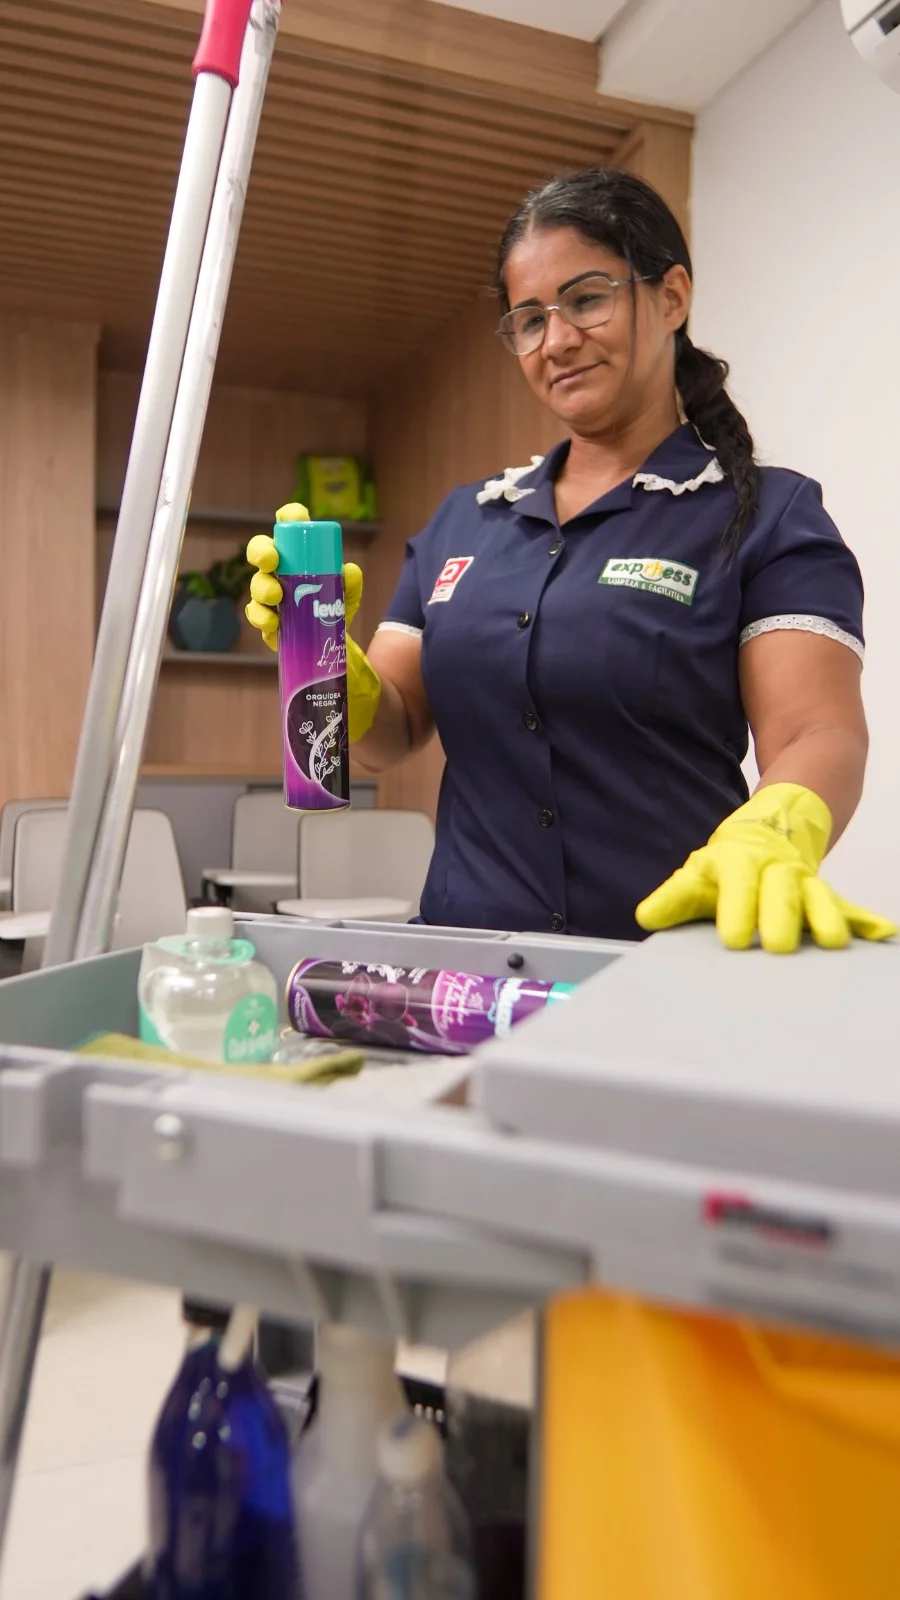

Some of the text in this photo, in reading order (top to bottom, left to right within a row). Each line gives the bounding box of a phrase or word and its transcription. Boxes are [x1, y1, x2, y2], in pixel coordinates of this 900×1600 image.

[610, 560, 692, 586] exprhess
[607, 577, 639, 588] LIMPEZA
[648, 583, 684, 602] FACILITIES
[317, 655, 328, 667] de
[305, 691, 341, 701] ORQUÍDEA
[312, 700, 337, 708] NEGRA
